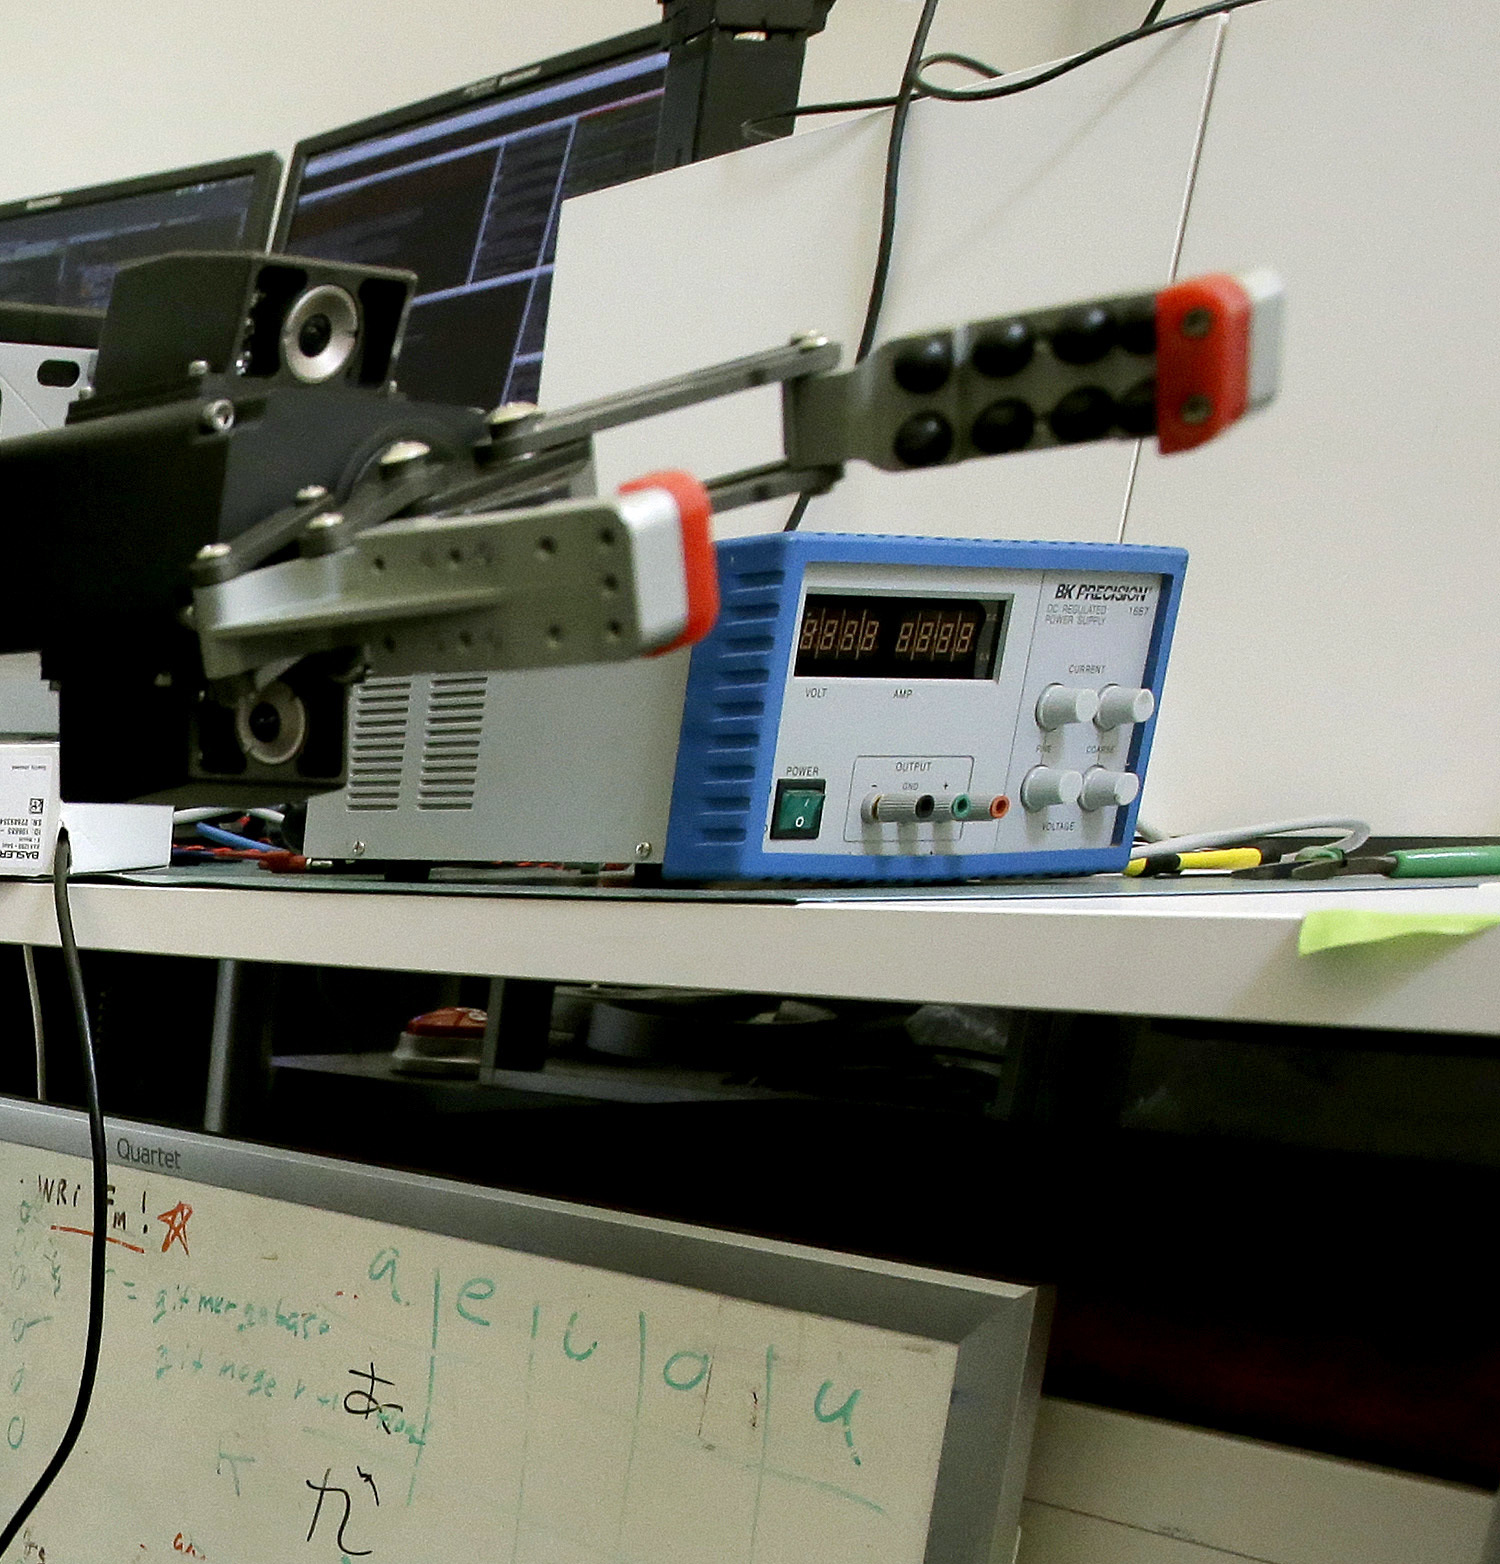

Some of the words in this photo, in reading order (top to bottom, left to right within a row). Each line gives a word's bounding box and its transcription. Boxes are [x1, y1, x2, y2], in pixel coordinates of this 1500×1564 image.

[1055, 584, 1076, 600] BK
[1077, 584, 1149, 601] PRECISION
[1068, 664, 1107, 675] CURRENT
[805, 687, 827, 698] VOLT
[893, 689, 913, 699] AMP
[786, 766, 819, 777] POWER
[896, 762, 932, 773] OUTPUT
[1042, 821, 1076, 832] VOLTAGE
[0, 850, 39, 860] BASLER
[116, 1137, 182, 1170] Quartet
